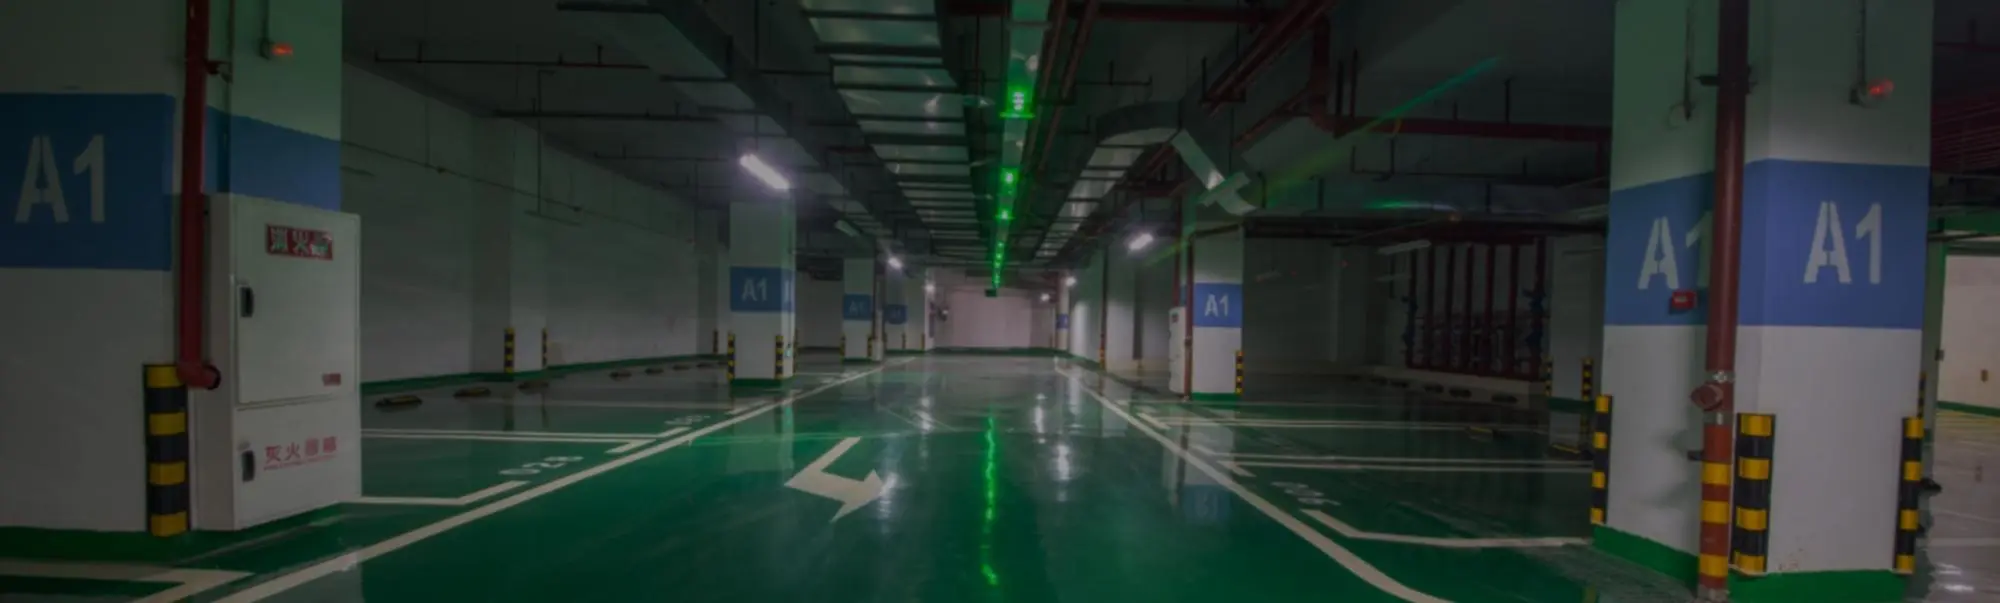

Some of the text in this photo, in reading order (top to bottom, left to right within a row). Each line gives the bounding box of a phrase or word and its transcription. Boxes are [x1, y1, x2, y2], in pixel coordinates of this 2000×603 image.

[14, 133, 105, 224] A1
[1637, 210, 1712, 290] A1
[1803, 200, 1882, 285] A1
[741, 277, 768, 302] A1
[1204, 294, 1230, 317] A1
